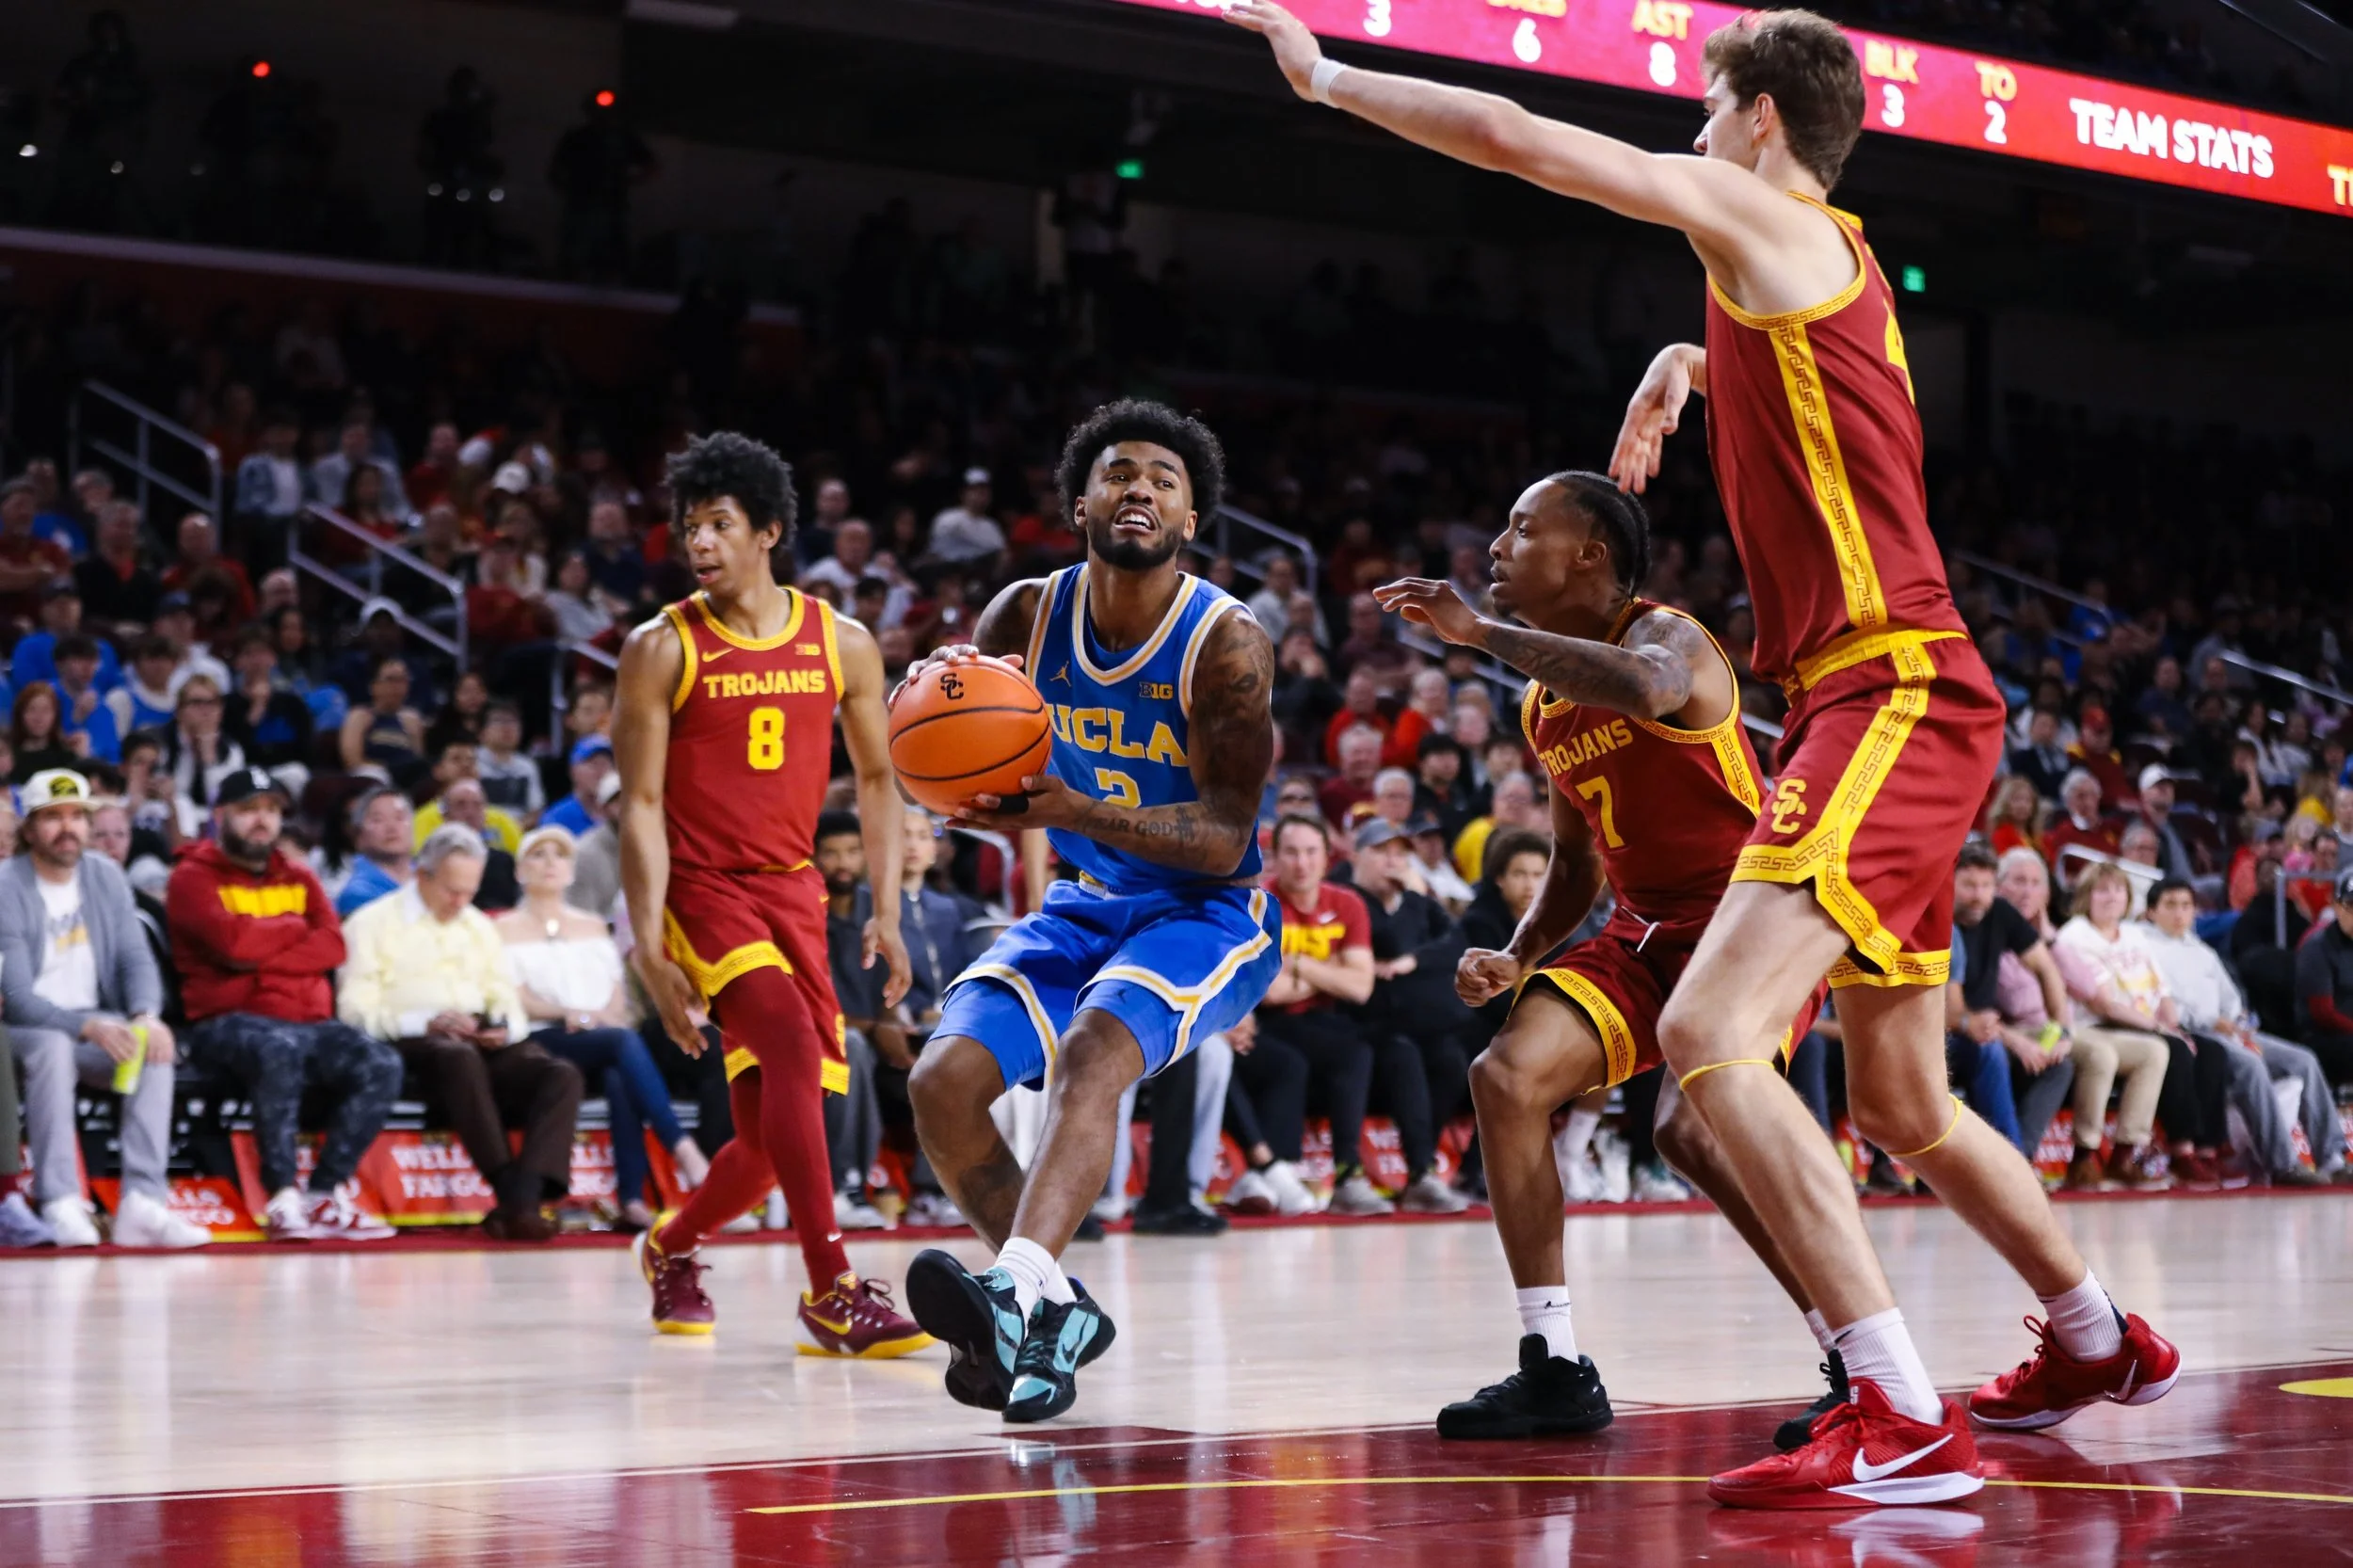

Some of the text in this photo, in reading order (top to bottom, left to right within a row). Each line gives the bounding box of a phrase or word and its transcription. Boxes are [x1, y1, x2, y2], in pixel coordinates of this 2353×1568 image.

[1513, 18, 1542, 63] 6
[1631, 1, 1693, 40] AST
[1649, 41, 1677, 87] 8
[1865, 40, 1920, 84] BLK
[1976, 61, 2017, 101] TO
[1881, 84, 1906, 127] 3
[1984, 101, 2007, 145] 2
[2070, 97, 2274, 178] TEAM STATS
[702, 669, 826, 698] TROJANS
[747, 707, 785, 770] 8
[1046, 703, 1188, 767] UCLA
[1539, 718, 1634, 776] TROJANS
[1135, 821, 1175, 836] GOD
[1575, 775, 1625, 848] 7
